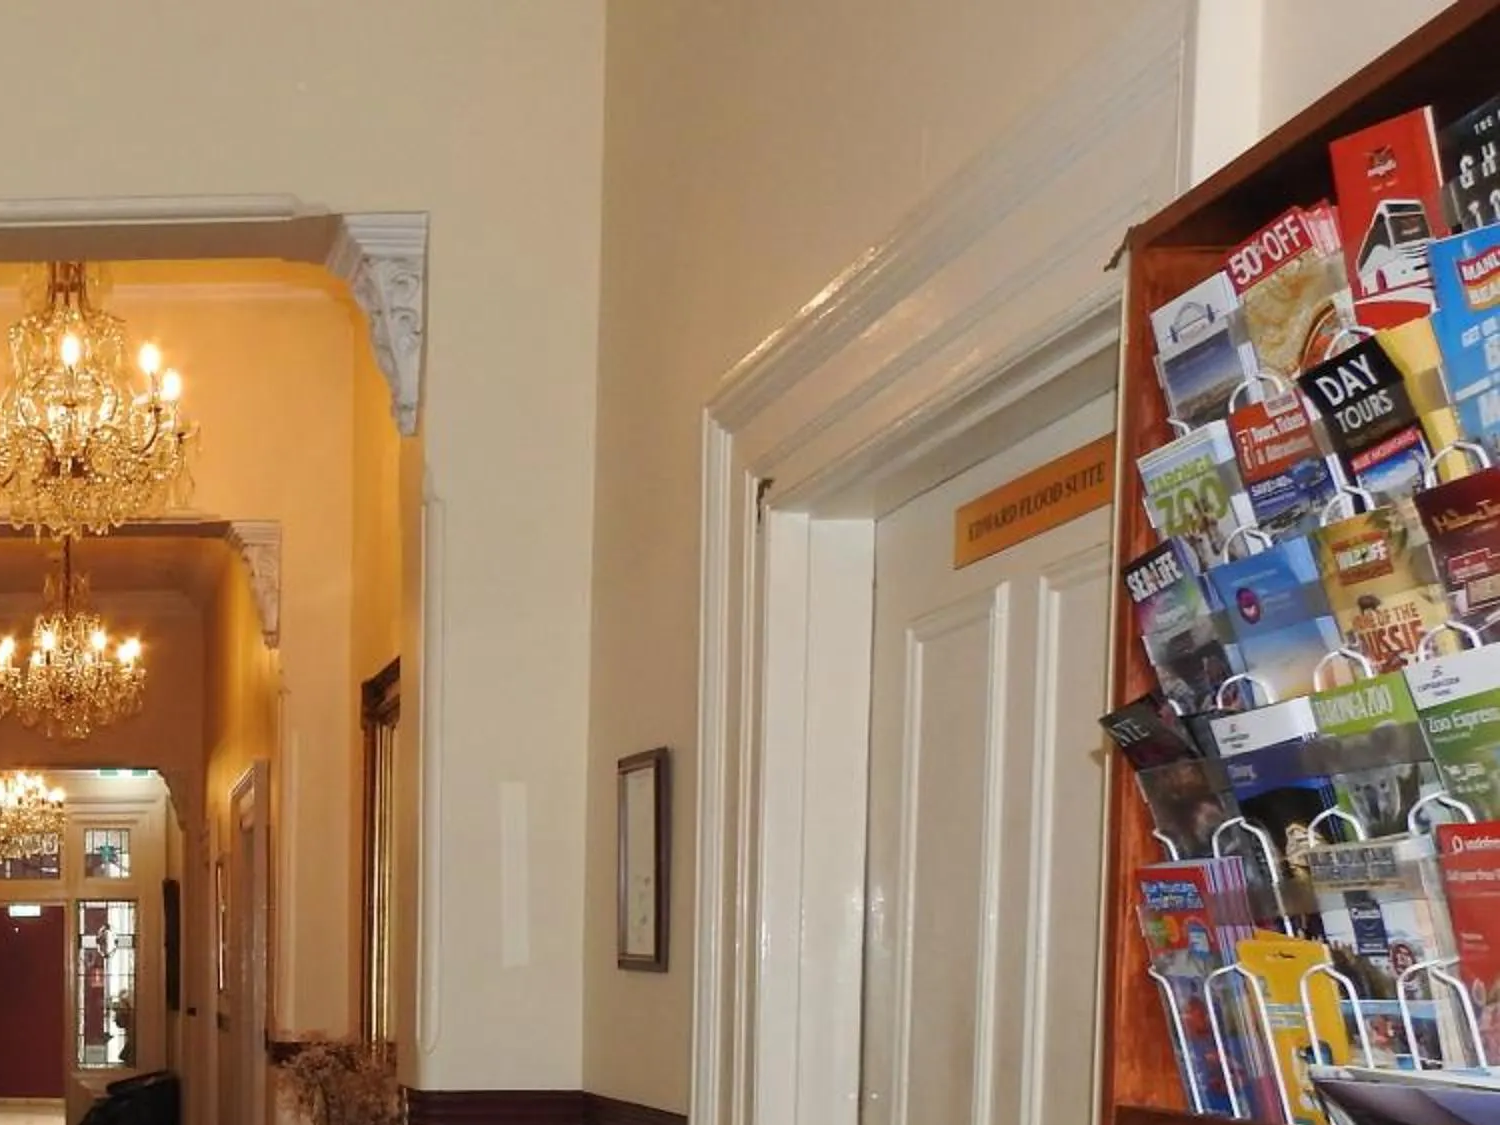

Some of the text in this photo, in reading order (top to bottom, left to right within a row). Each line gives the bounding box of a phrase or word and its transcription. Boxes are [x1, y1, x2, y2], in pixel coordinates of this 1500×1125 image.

[1262, 215, 1301, 261] OFF
[1315, 353, 1378, 407] DAY
[1334, 388, 1394, 433] TOURS
[1019, 481, 1064, 517] FLOOD
[1064, 461, 1106, 498] SUITE
[1154, 474, 1230, 537] ZOO
